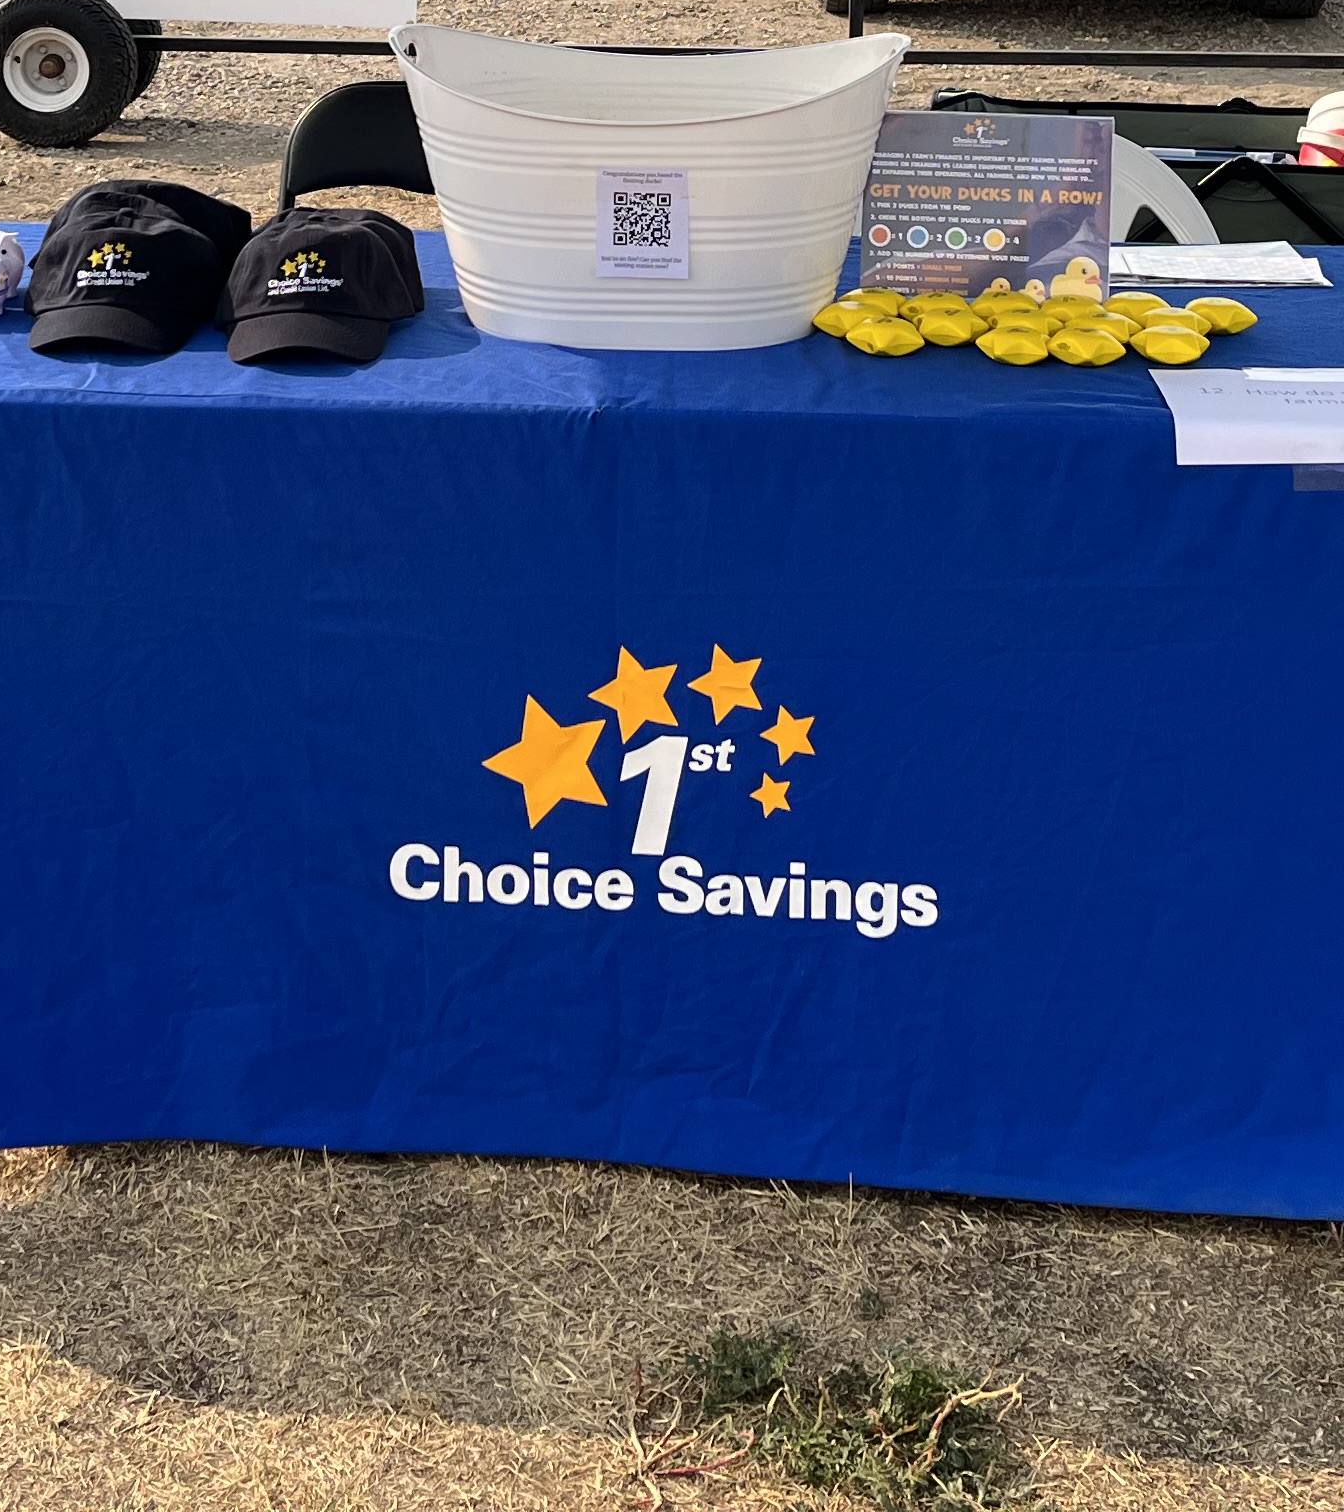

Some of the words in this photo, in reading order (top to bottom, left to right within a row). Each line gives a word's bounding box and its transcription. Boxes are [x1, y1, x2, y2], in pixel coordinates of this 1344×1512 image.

[869, 183, 902, 198] GET
[906, 184, 952, 200] YOUR
[958, 186, 1012, 202] DUCKS
[1017, 188, 1034, 203] IN
[1040, 189, 1053, 203] A
[1058, 190, 1103, 206] ROW!
[898, 232, 903, 240] 1
[936, 234, 943, 242] 2
[974, 235, 981, 243] 3
[1013, 236, 1020, 245] 4
[893, 262, 916, 270] POINTS
[77, 269, 108, 279] Choice
[267, 276, 301, 288] Choice
[302, 276, 342, 288] Savings
[1199, 387, 1233, 395] 12.
[1246, 388, 1297, 396] How
[1305, 389, 1334, 397] do
[619, 735, 736, 856] 1st
[388, 842, 635, 912] Choice
[657, 855, 939, 940] Savings
